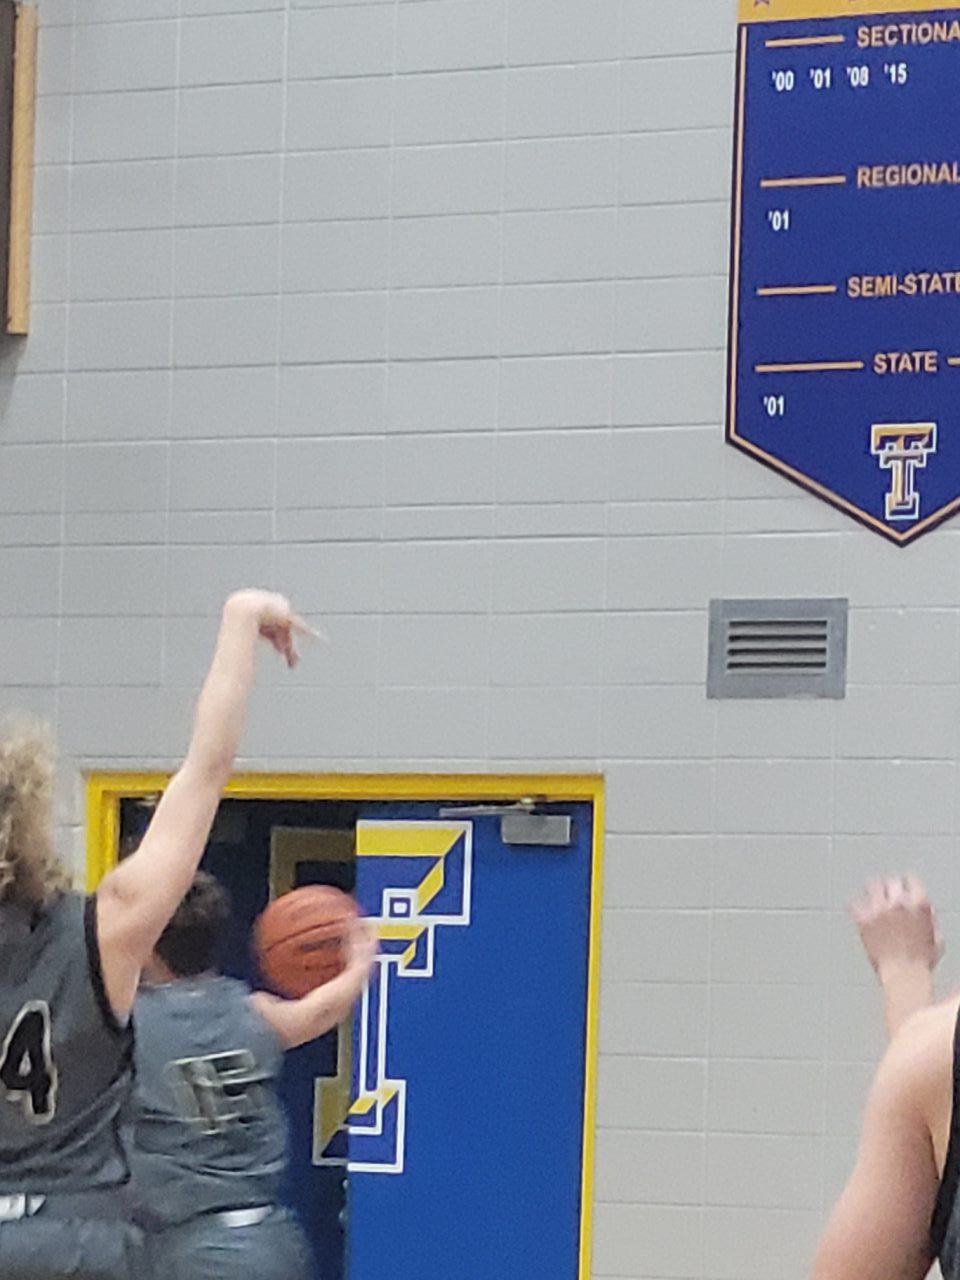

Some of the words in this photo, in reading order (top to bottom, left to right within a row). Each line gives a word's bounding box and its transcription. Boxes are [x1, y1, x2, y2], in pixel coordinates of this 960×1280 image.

[772, 70, 794, 91] '00
[810, 66, 831, 89] '01
[884, 62, 907, 84] '15
[768, 210, 789, 231] '01
[874, 351, 938, 374] STATE
[763, 396, 785, 416] '01
